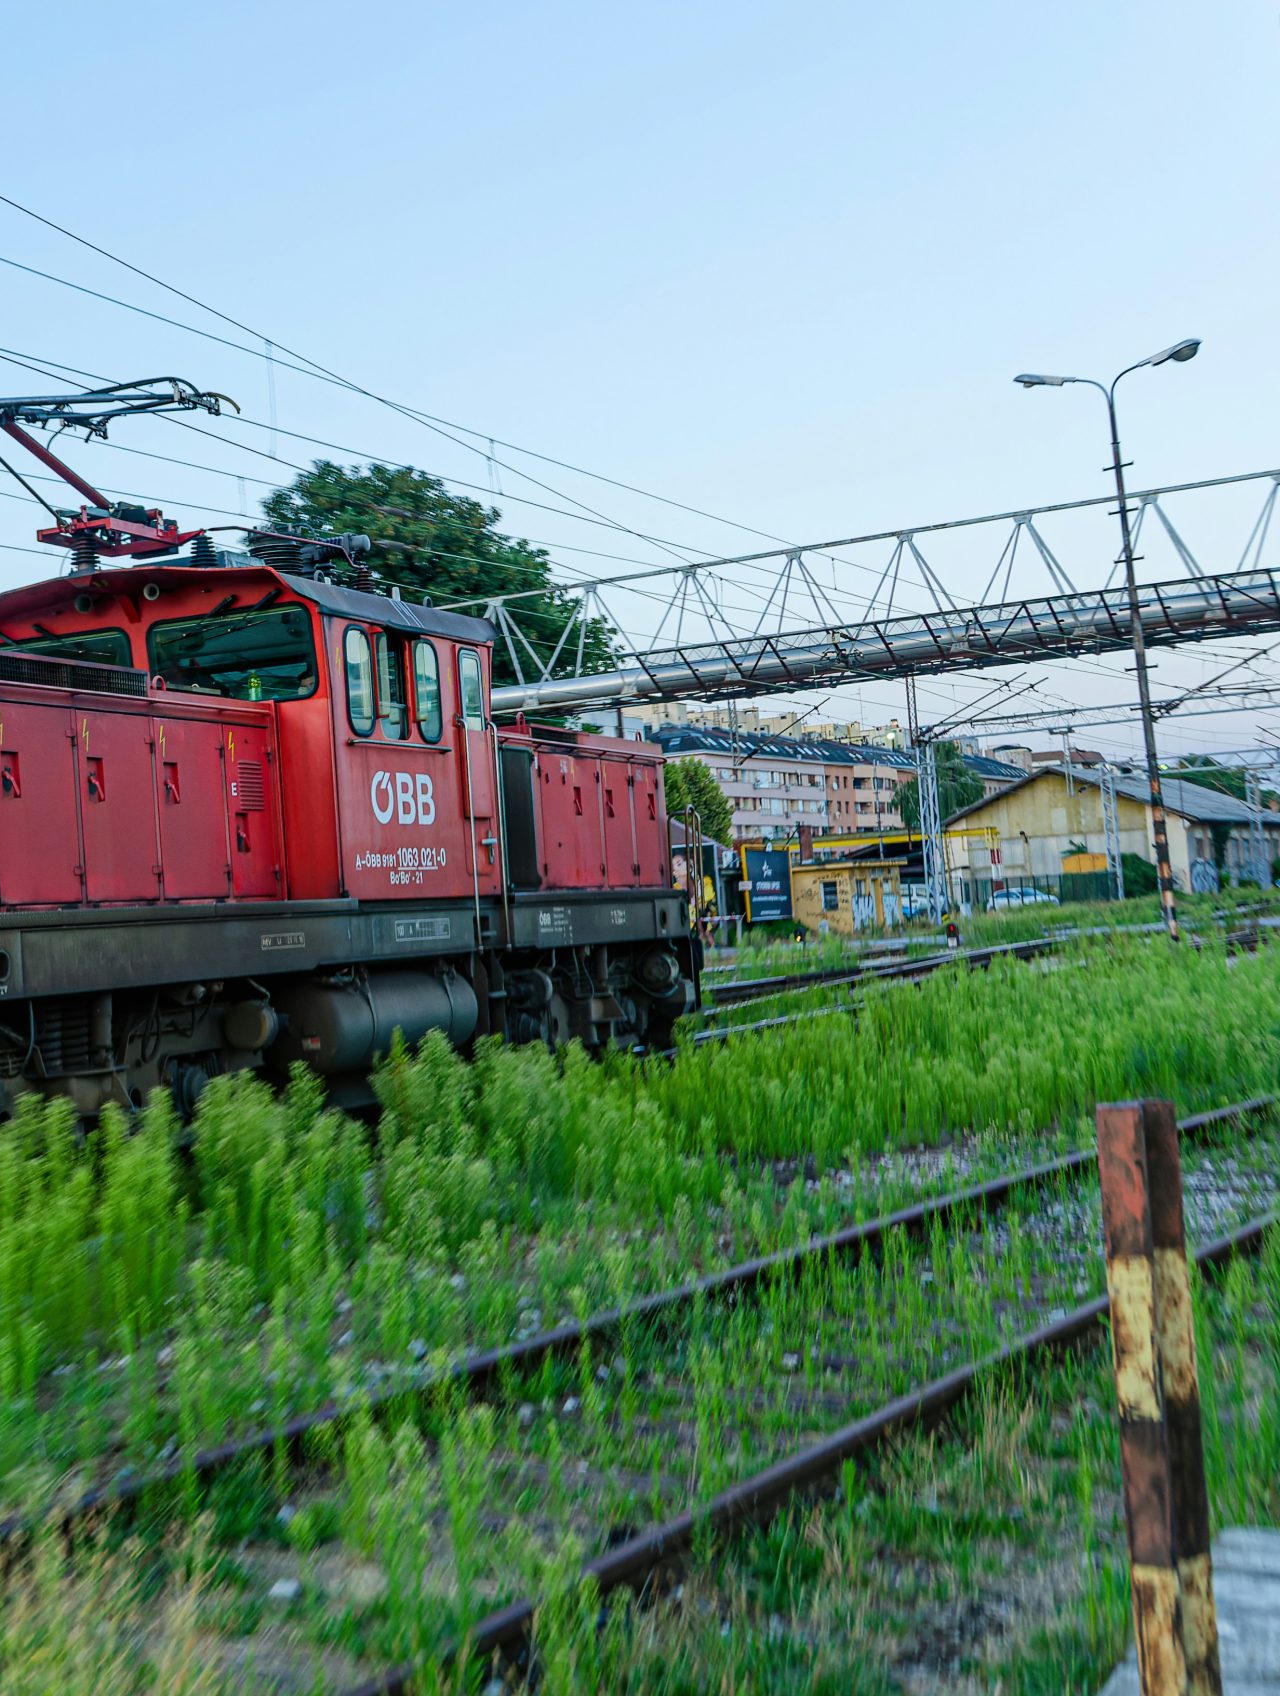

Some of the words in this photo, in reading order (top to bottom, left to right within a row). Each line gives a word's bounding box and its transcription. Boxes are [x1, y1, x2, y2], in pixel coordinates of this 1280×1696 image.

[231, 782, 238, 796] E
[370, 770, 437, 826] ÖBB
[397, 847, 419, 868] 1063
[420, 847, 447, 867] 021-0
[415, 871, 423, 884] 21
